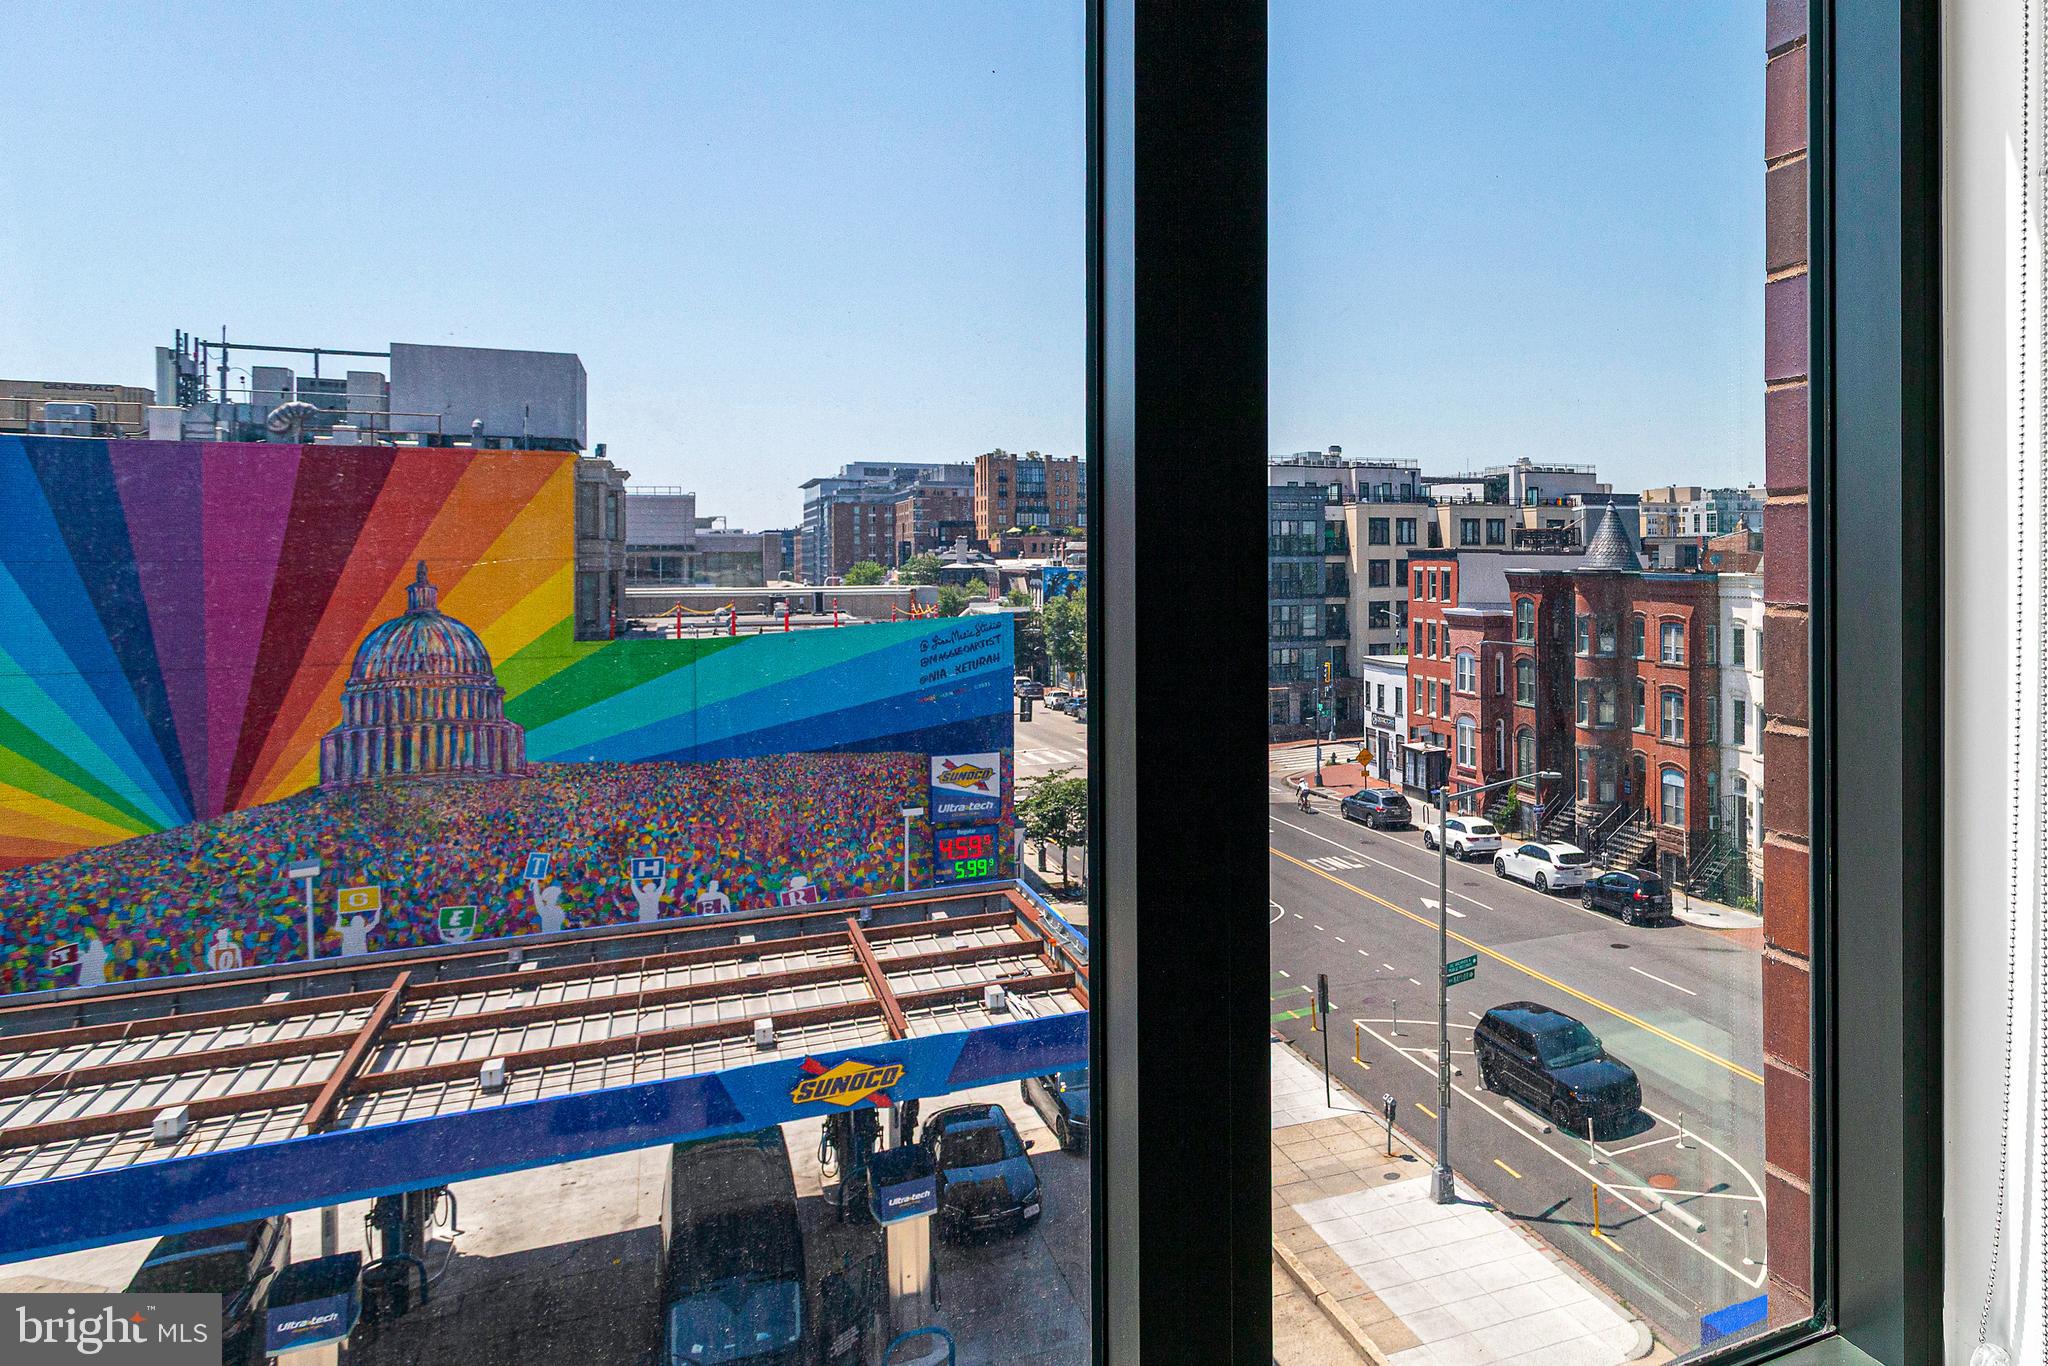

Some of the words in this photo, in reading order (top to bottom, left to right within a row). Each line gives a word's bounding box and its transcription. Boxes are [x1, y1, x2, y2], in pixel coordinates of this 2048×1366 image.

[43, 382, 115, 392] GENERAC
[942, 768, 991, 781] SUNOCO
[1307, 855, 1371, 872] ONLY
[533, 858, 545, 875] T
[639, 861, 660, 876] H
[789, 890, 807, 906] R
[798, 1066, 899, 1100] SUNOCO
